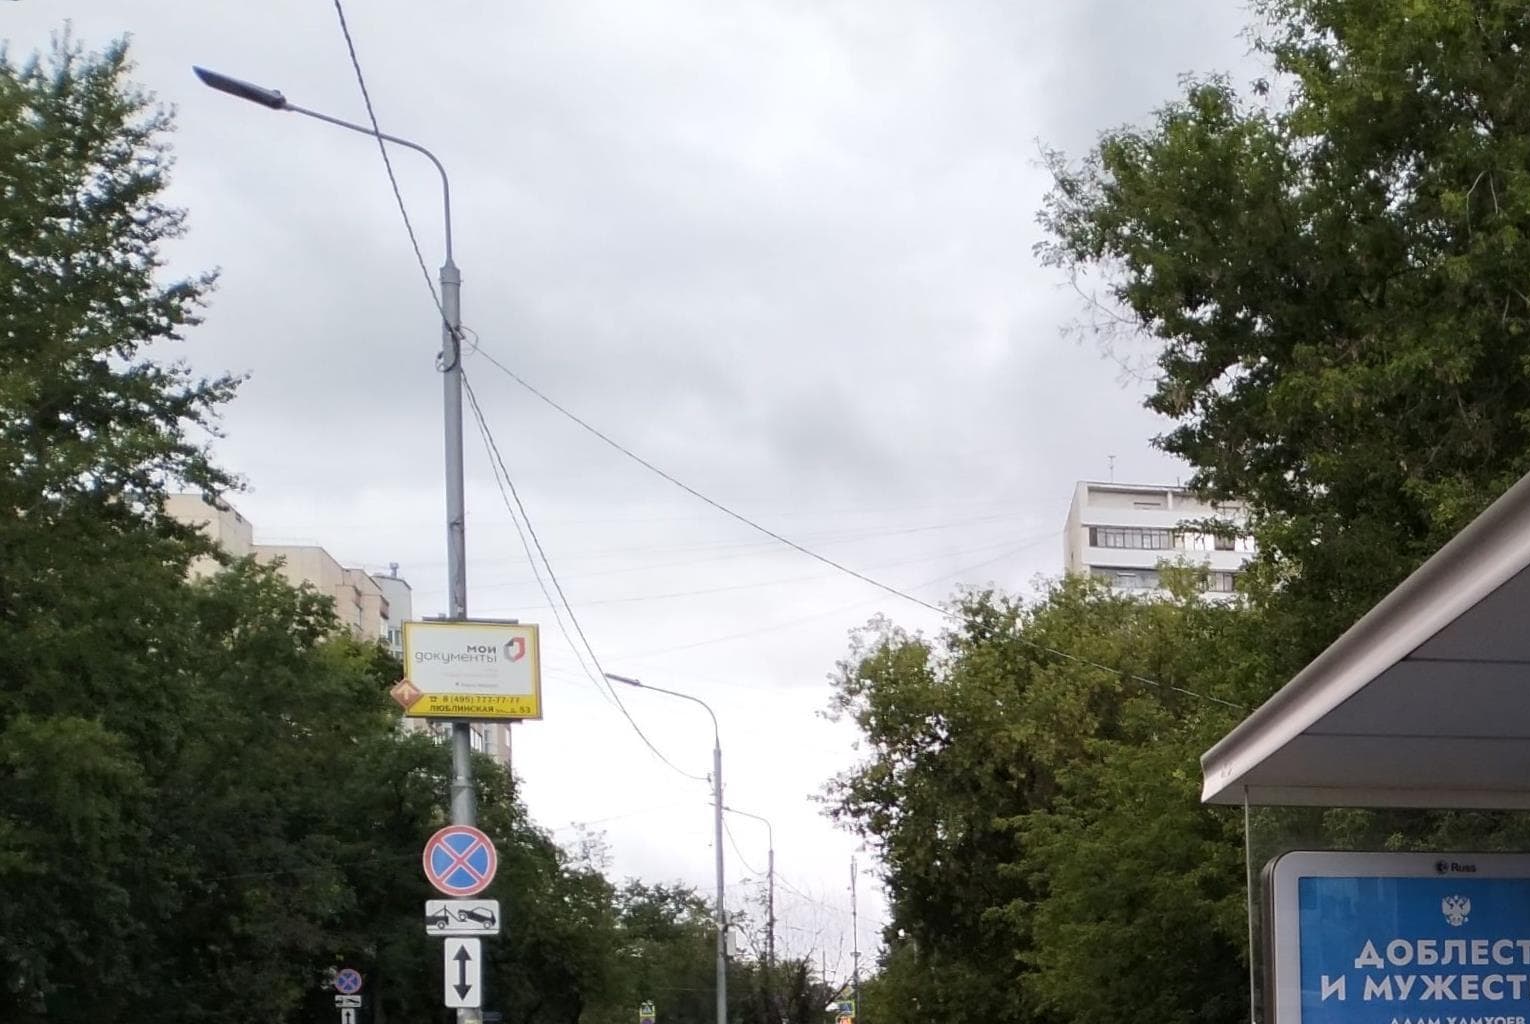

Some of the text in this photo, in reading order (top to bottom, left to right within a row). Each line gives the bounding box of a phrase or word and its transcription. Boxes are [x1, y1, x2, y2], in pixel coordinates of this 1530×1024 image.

[415, 651, 497, 664] документы
[430, 705, 495, 713] ЛЮБЛИНСКАЯ
[1321, 975, 1346, 1001] И
